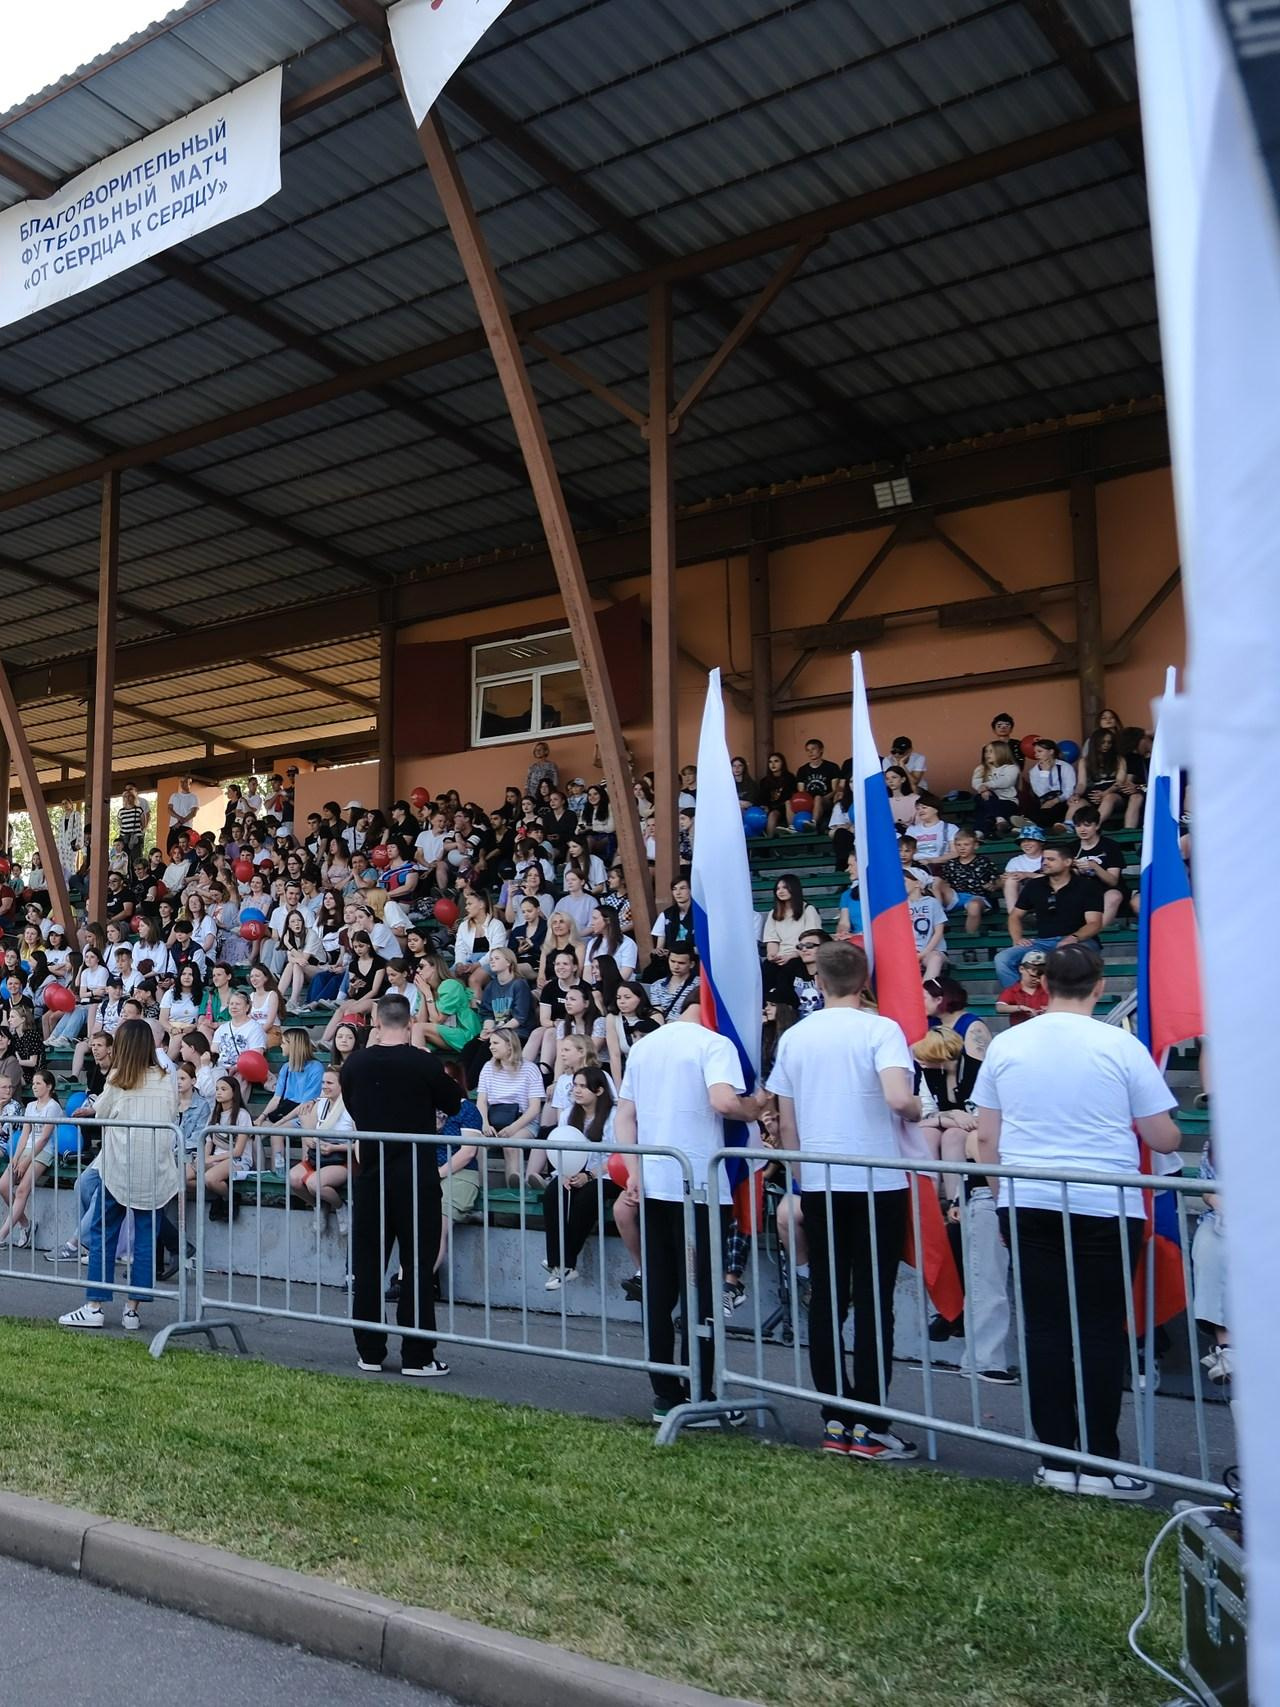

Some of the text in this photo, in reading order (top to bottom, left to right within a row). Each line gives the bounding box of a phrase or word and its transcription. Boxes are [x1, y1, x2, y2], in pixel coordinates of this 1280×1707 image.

[19, 117, 228, 242] БЛАГОТВОРИТЕЛЬНЫЙ
[21, 146, 228, 265] ФУТБОЛЬНЫЙ МАТЧ
[23, 178, 228, 291] «ОТ СЕРДЦА К СЕРДЦУ»
[908, 905, 929, 916] OVE
